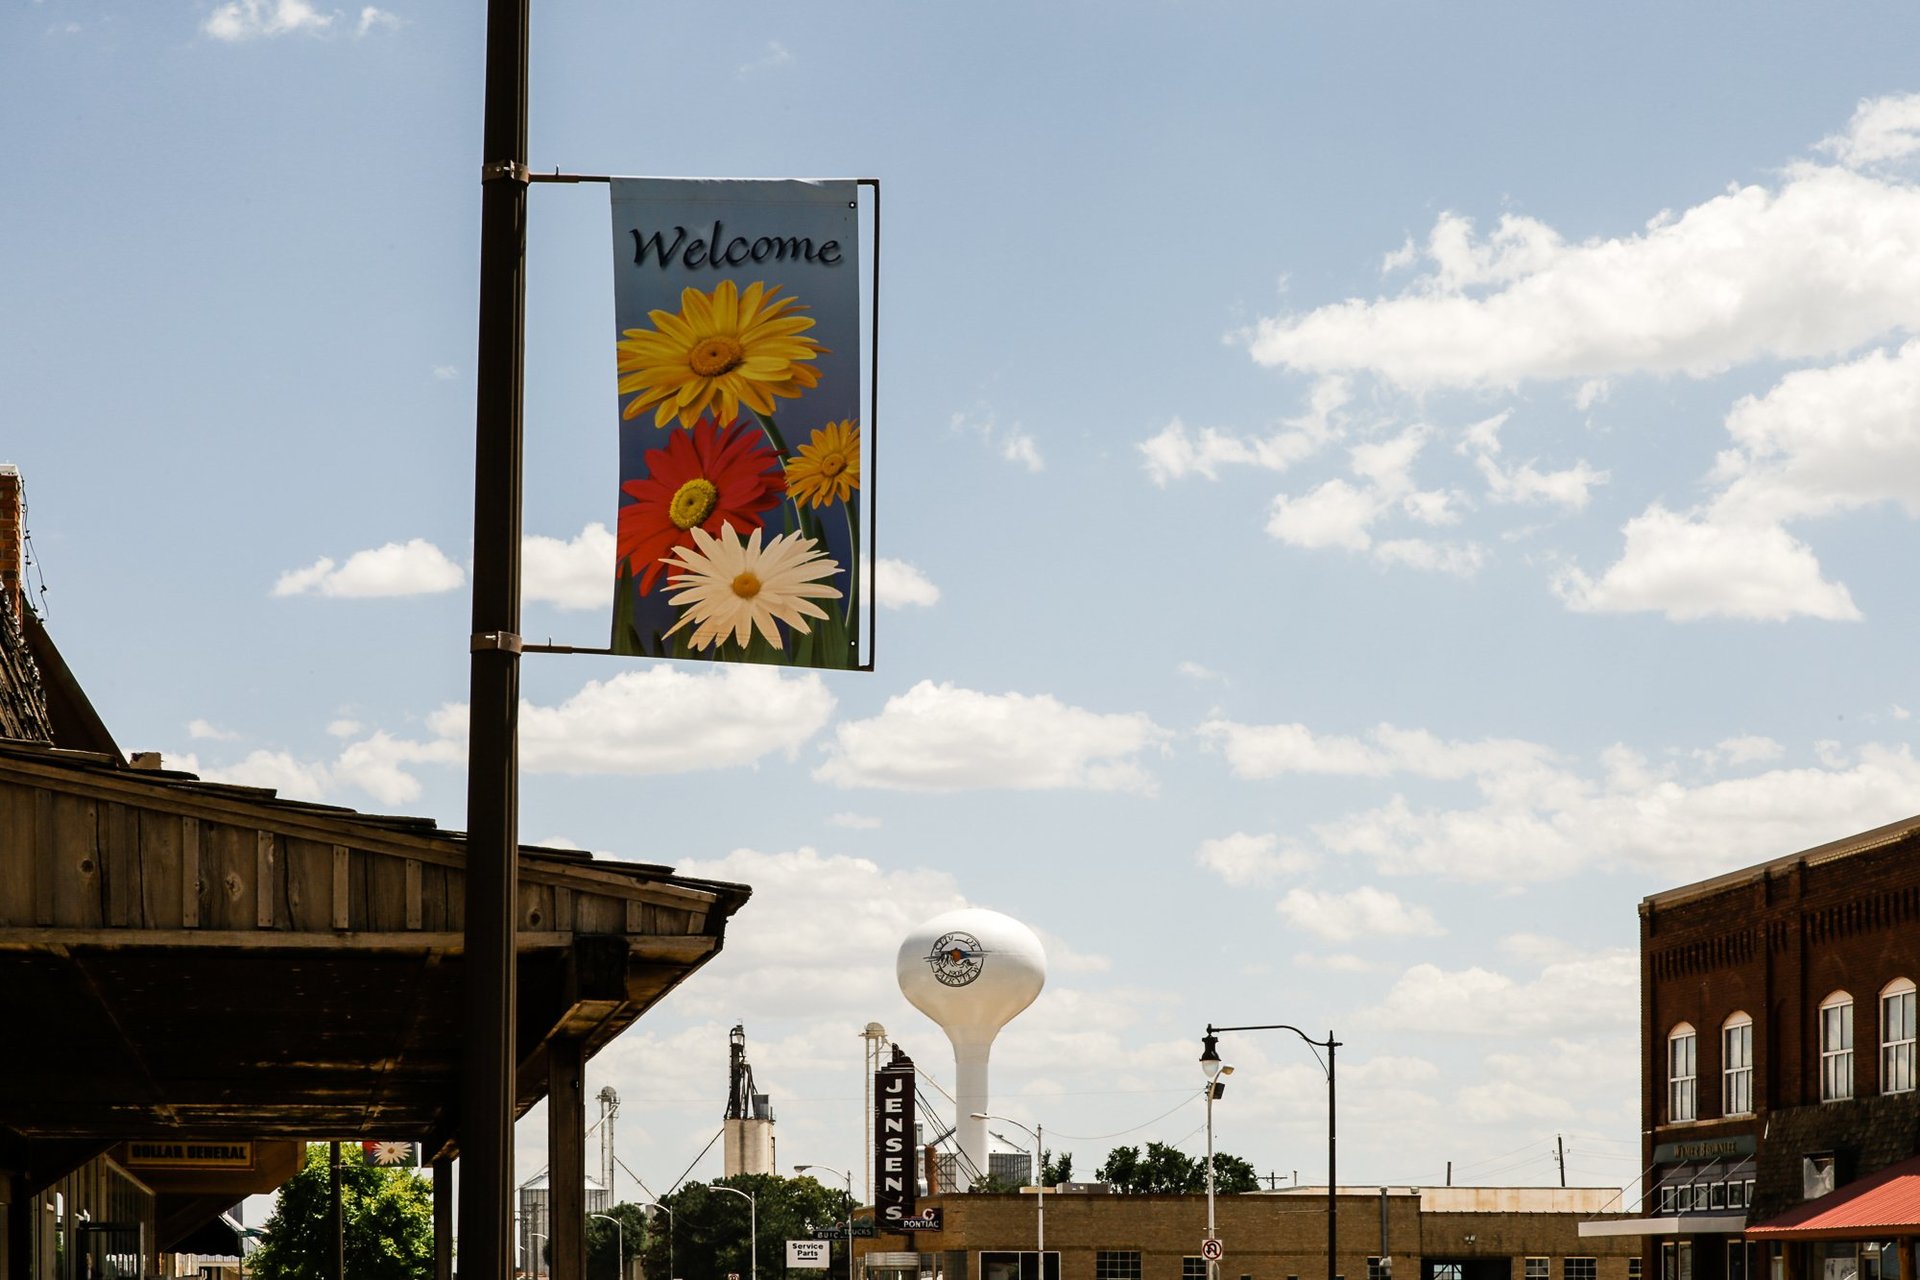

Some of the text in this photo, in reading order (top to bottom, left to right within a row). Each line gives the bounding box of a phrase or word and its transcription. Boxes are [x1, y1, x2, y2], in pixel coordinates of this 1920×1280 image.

[629, 220, 842, 269] Welcome
[132, 1145, 247, 1160] DOLLAR GENERAL
[885, 1078, 903, 1221] JENSEN'S
[903, 1220, 940, 1228] PONTIAC
[817, 1231, 842, 1239] BUIC
